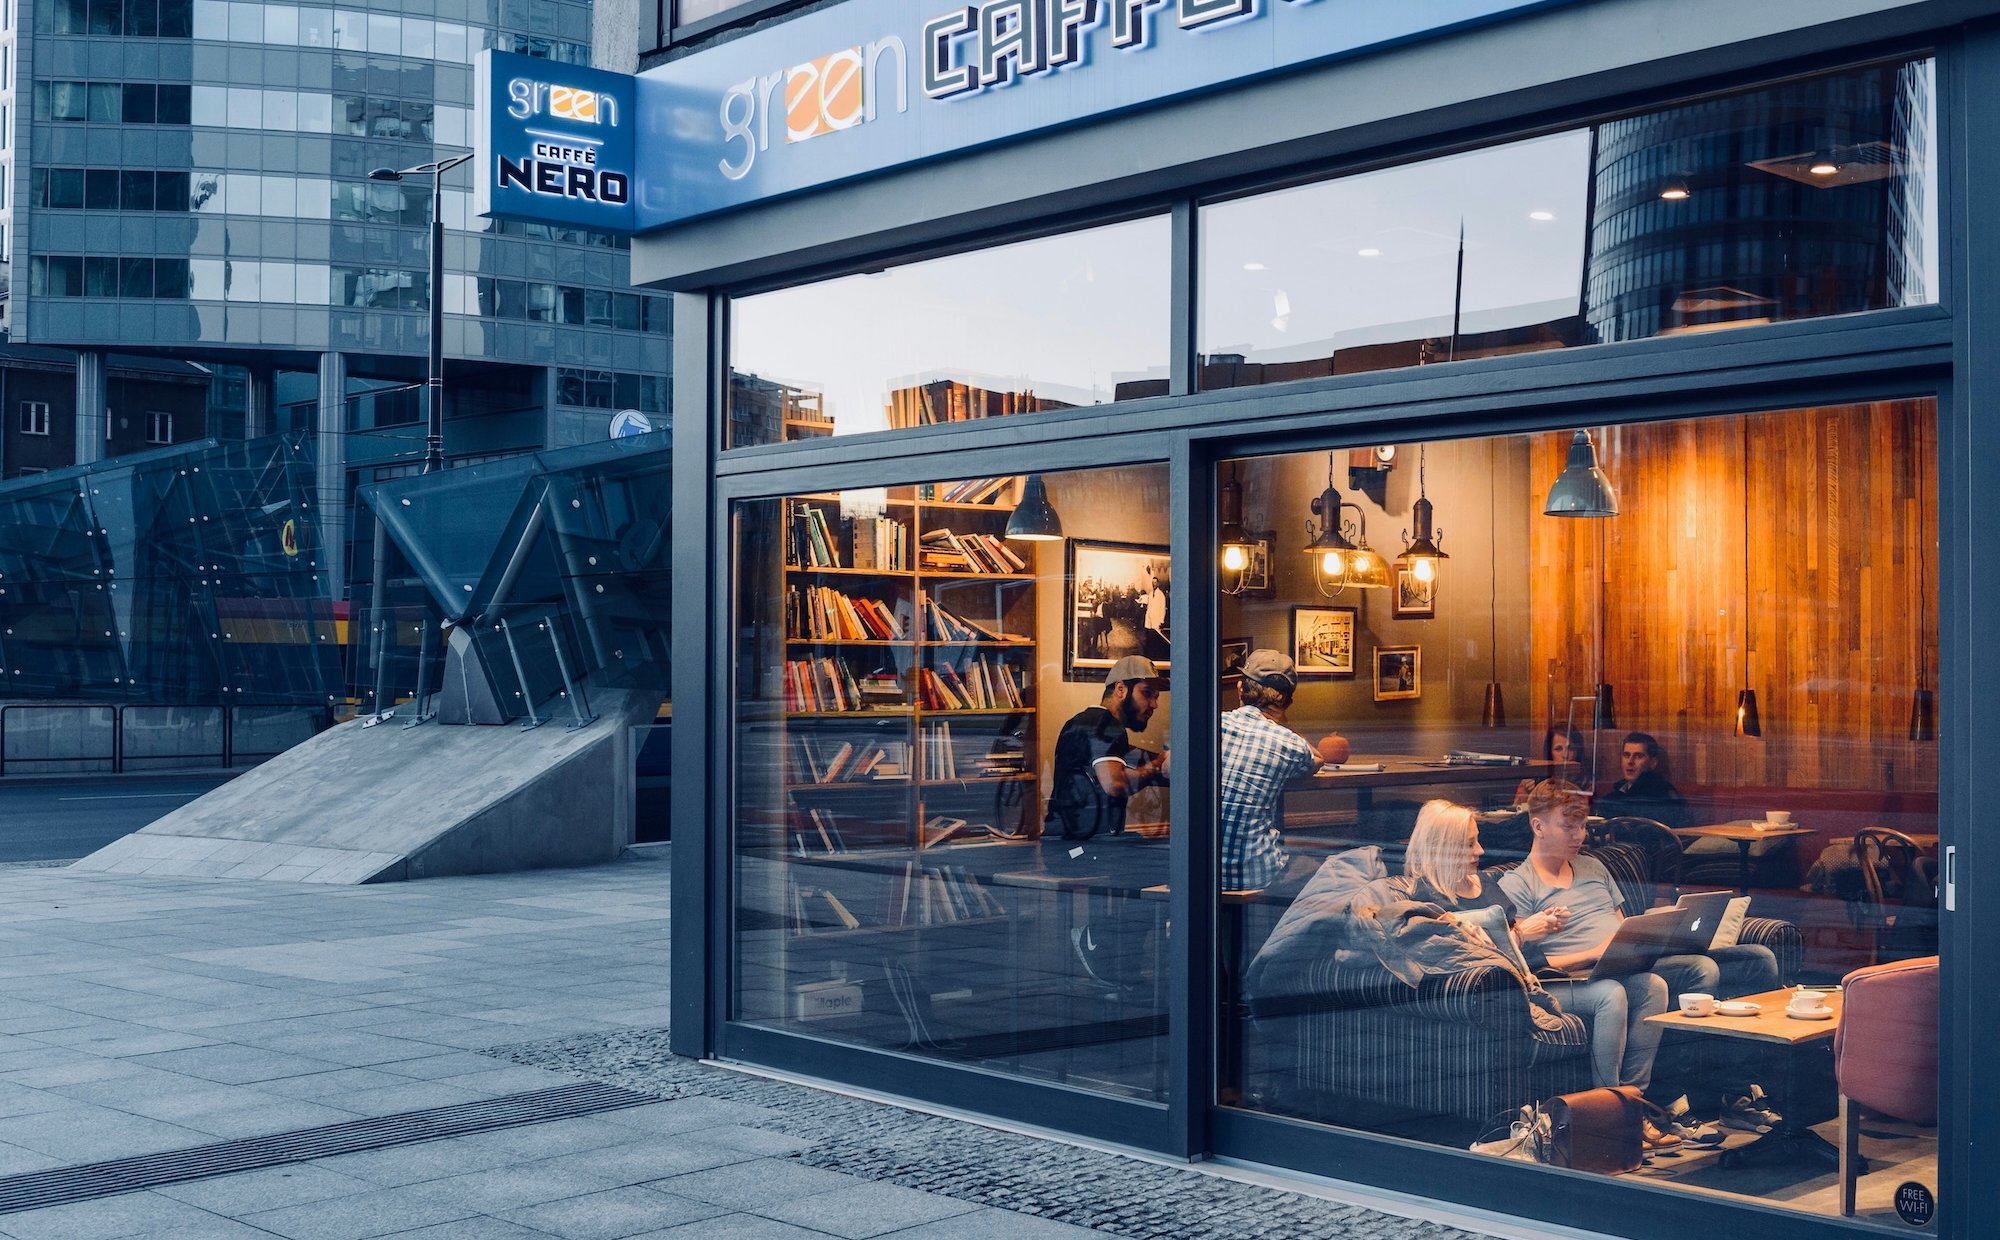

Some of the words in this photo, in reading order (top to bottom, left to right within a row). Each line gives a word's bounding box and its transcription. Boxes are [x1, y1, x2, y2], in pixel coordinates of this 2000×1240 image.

[507, 78, 618, 127] green
[718, 34, 908, 181] green
[537, 143, 596, 164] CAFFÈ
[497, 153, 629, 205] NERO
[1899, 1199, 1928, 1214] WI-FI
[1902, 1188, 1924, 1201] FREE
